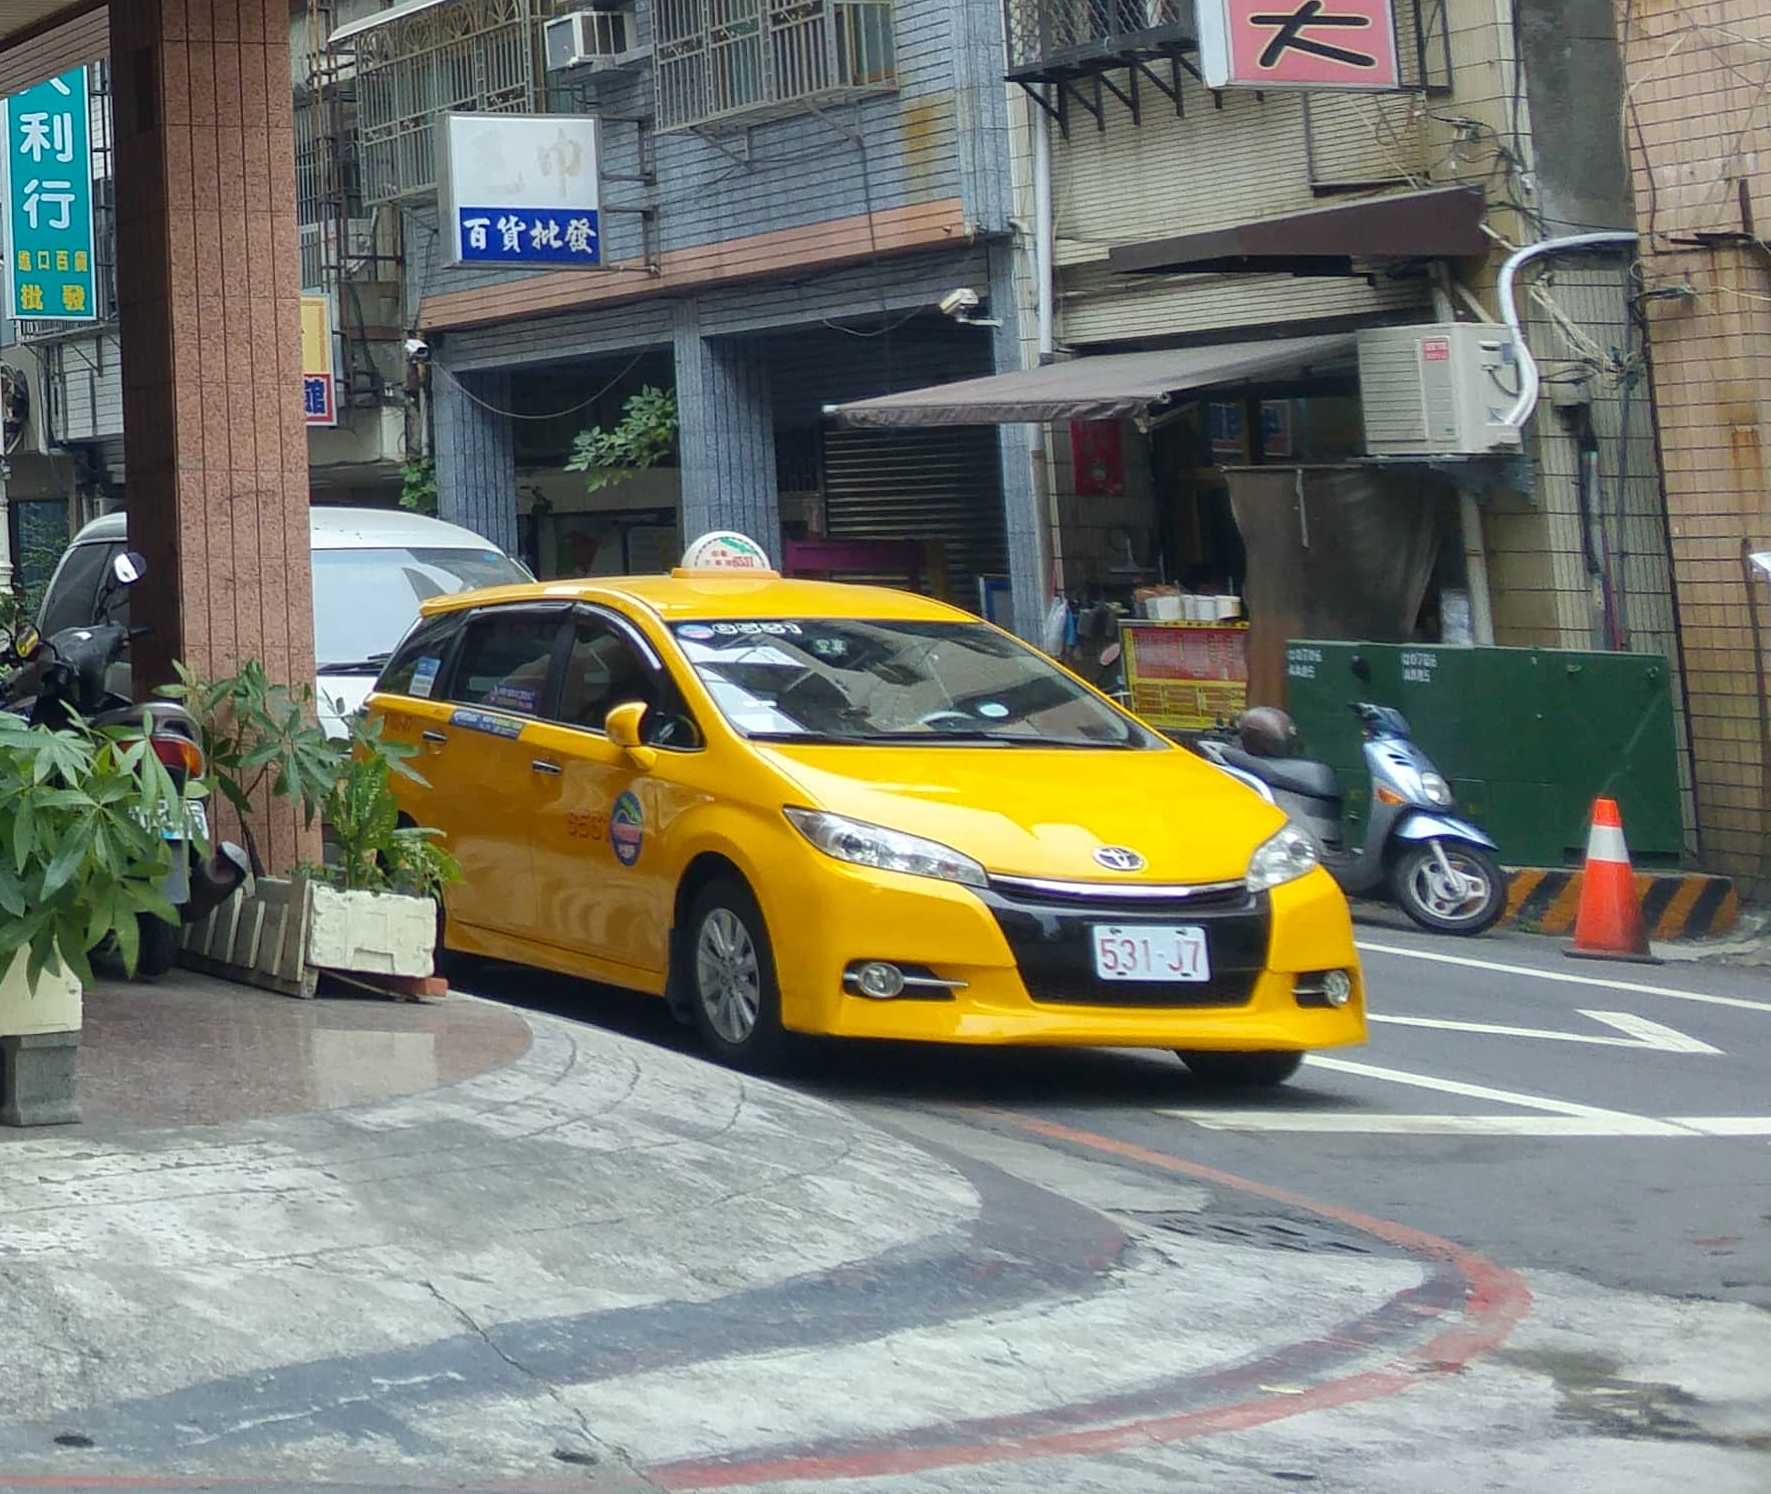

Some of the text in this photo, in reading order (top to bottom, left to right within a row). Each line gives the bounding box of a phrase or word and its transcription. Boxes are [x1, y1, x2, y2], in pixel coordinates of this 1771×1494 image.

[463, 216, 598, 254] 百貨批發
[1100, 930, 1206, 975] 531-J7
